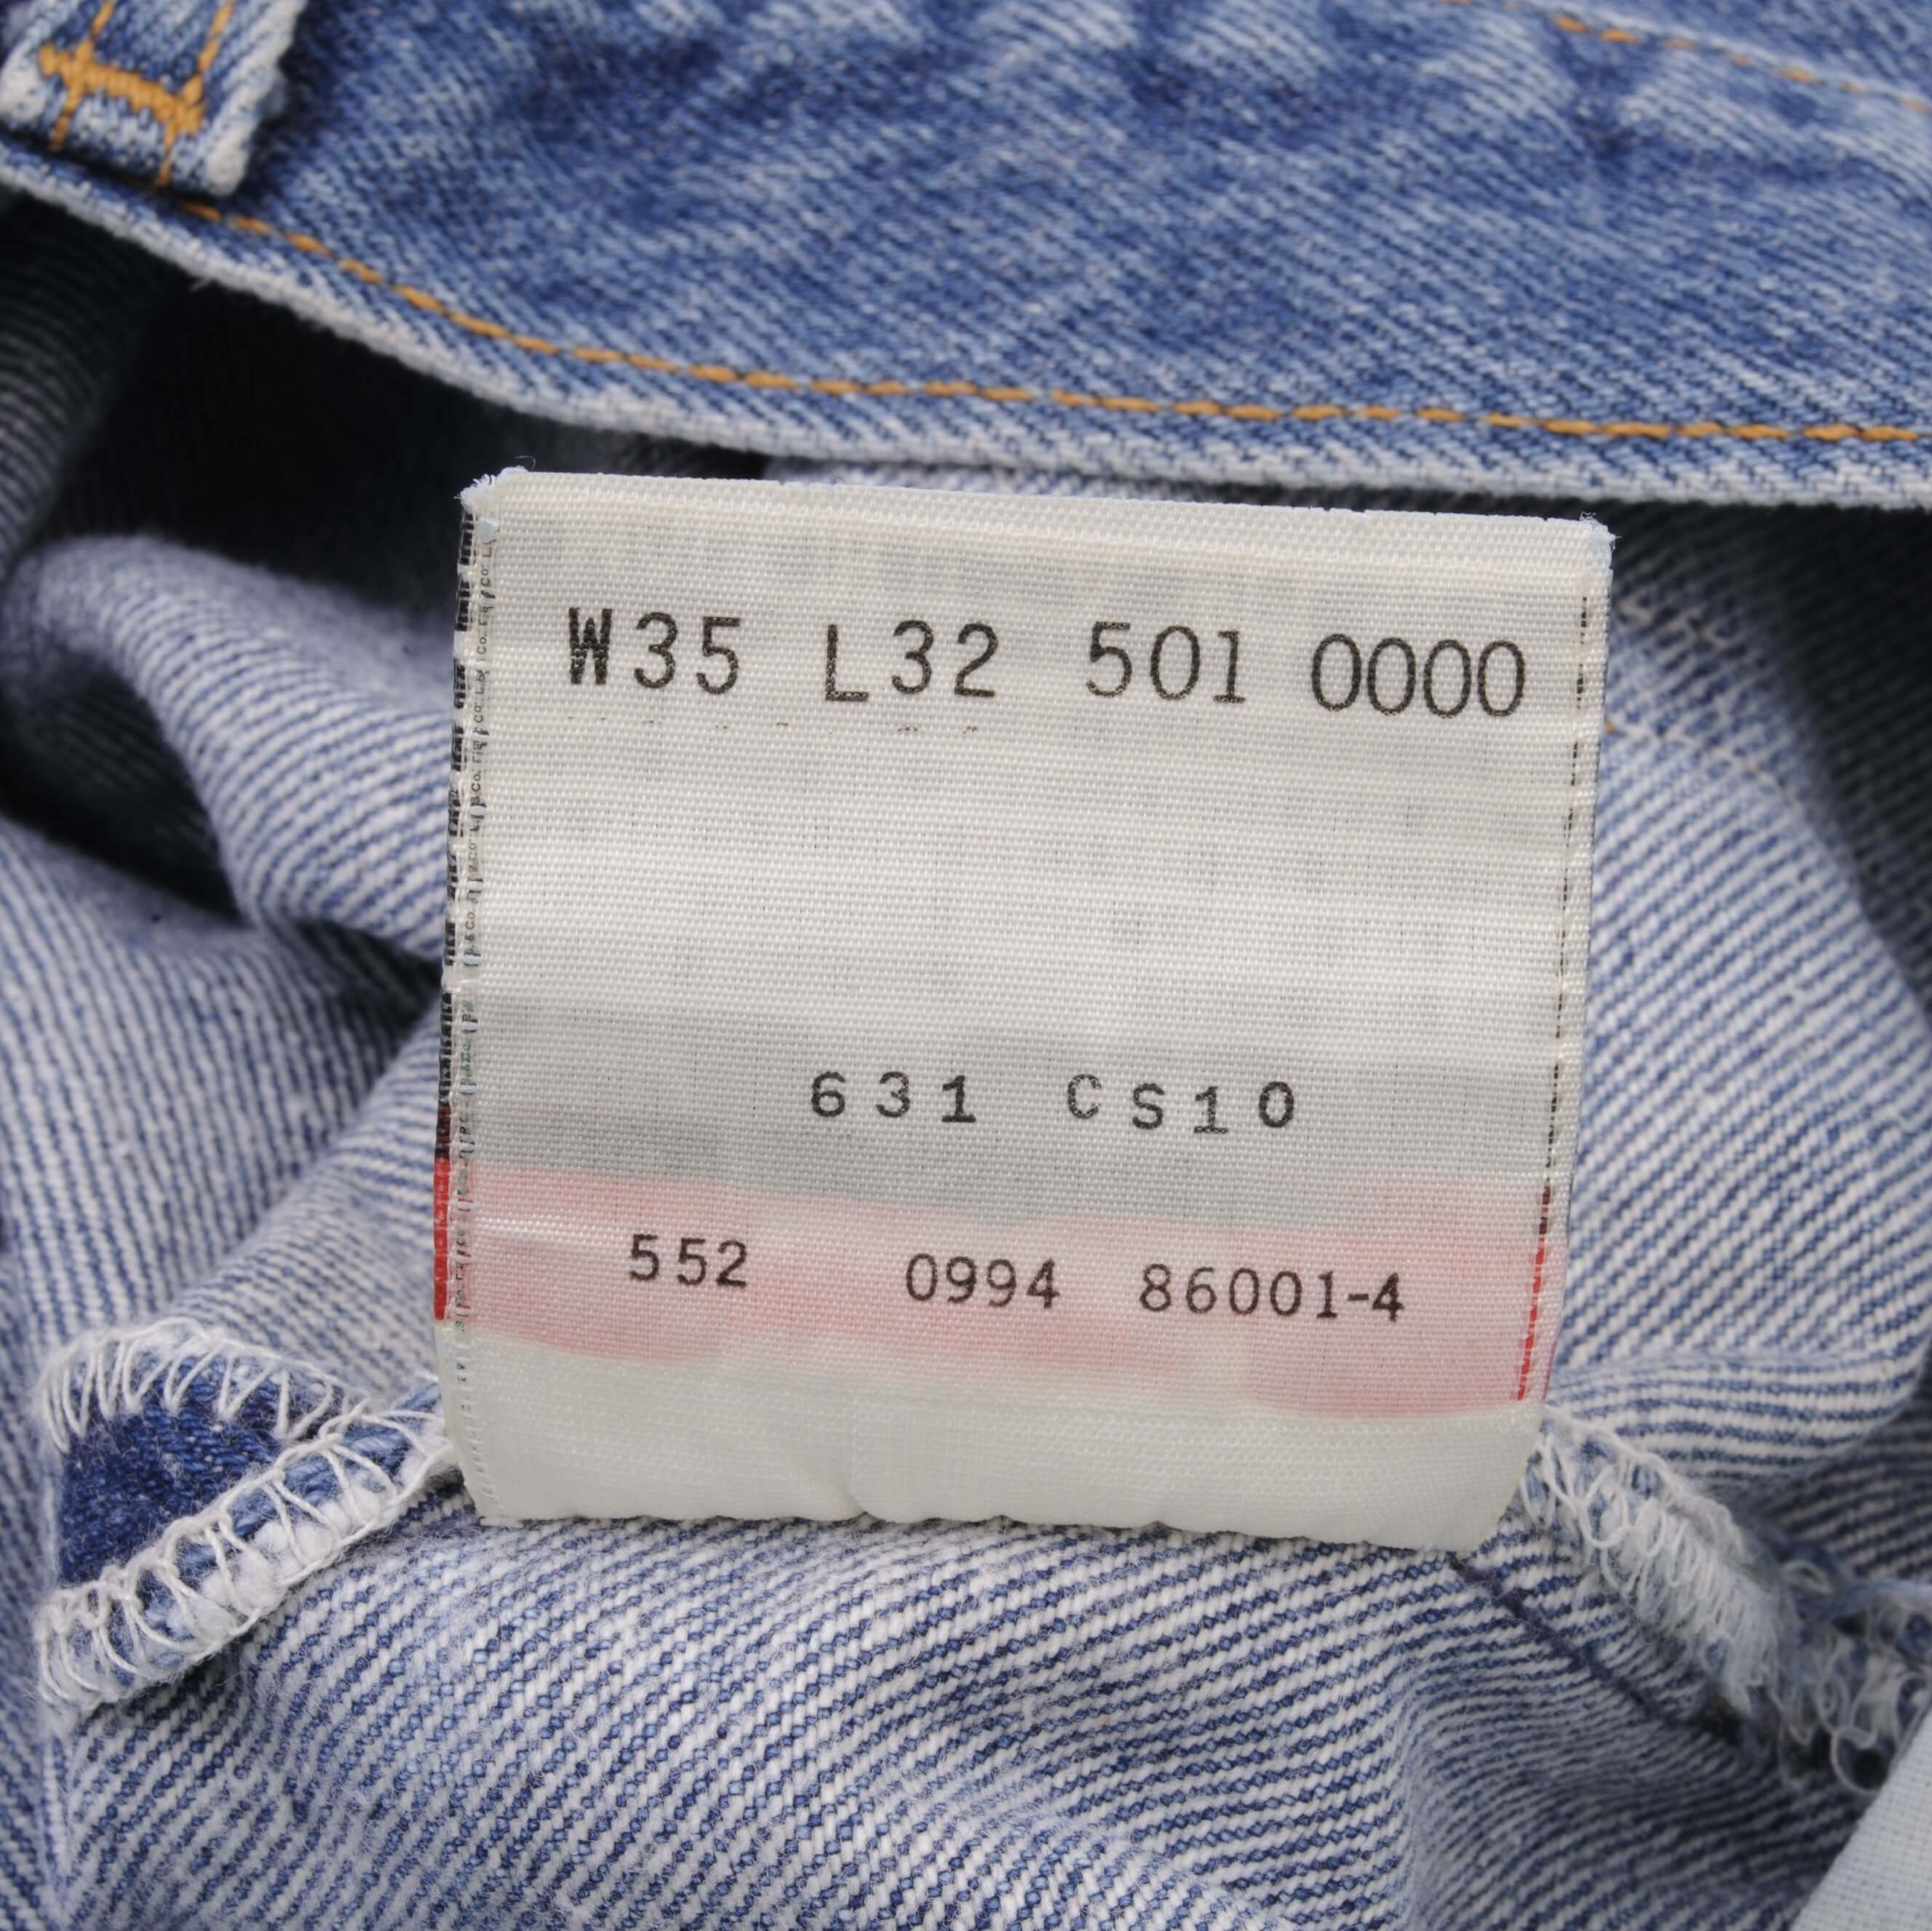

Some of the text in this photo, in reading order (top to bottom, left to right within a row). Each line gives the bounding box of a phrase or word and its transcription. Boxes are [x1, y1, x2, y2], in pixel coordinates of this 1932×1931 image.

[567, 605, 1527, 720] W35 L32 501 0000
[810, 1070, 1296, 1136] 631 CS10
[627, 1233, 1406, 1323] 552 0994 86001-4
